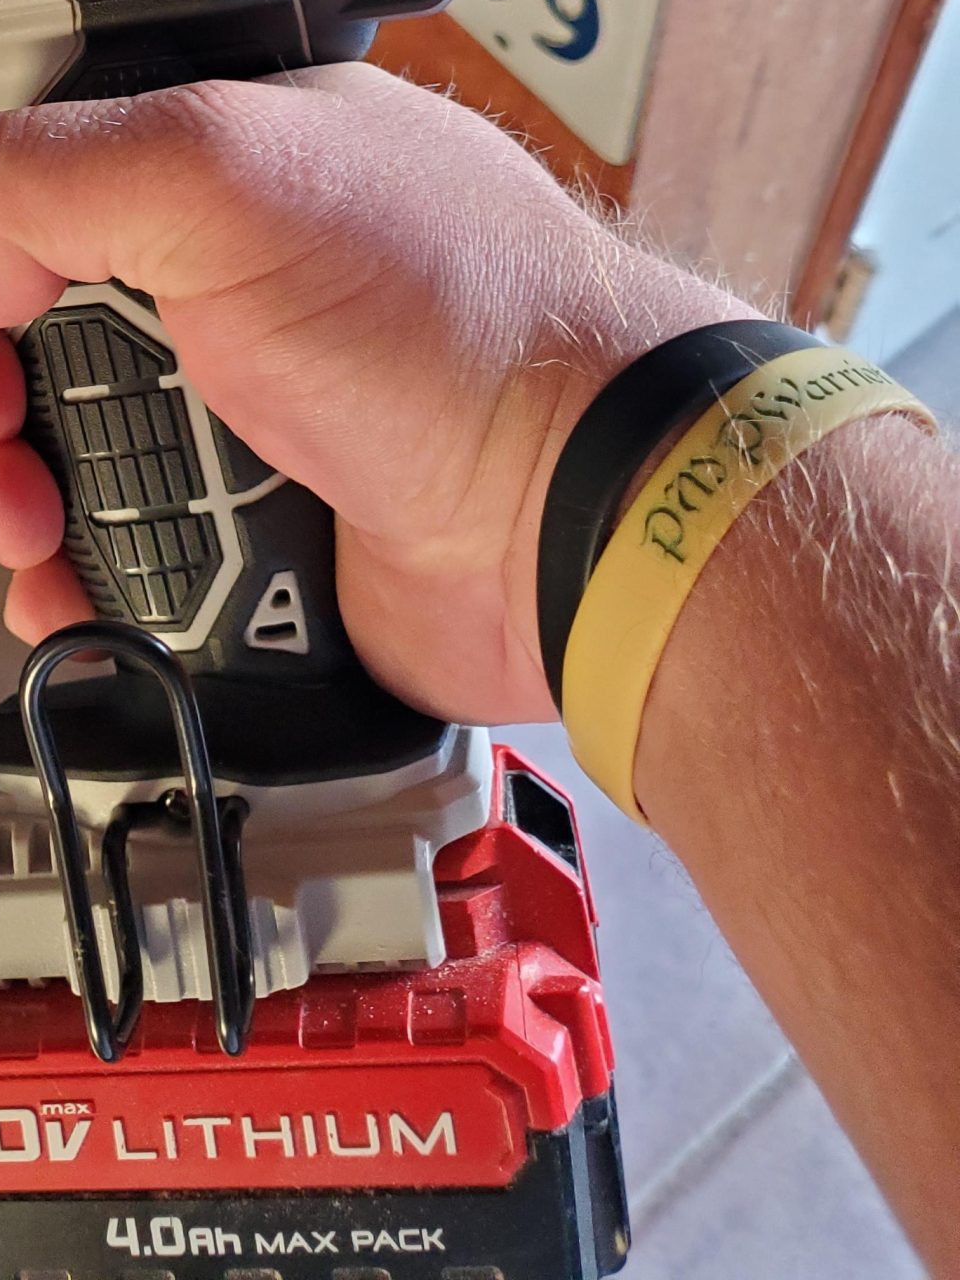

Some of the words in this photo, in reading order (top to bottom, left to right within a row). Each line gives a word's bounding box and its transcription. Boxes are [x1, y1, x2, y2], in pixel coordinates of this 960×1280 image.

[41, 1101, 90, 1116] max
[114, 1111, 457, 1159] LITHIUM
[105, 1217, 240, 1257] 4.0Ah
[255, 1232, 337, 1255] MAX
[352, 1228, 446, 1253] PACK
